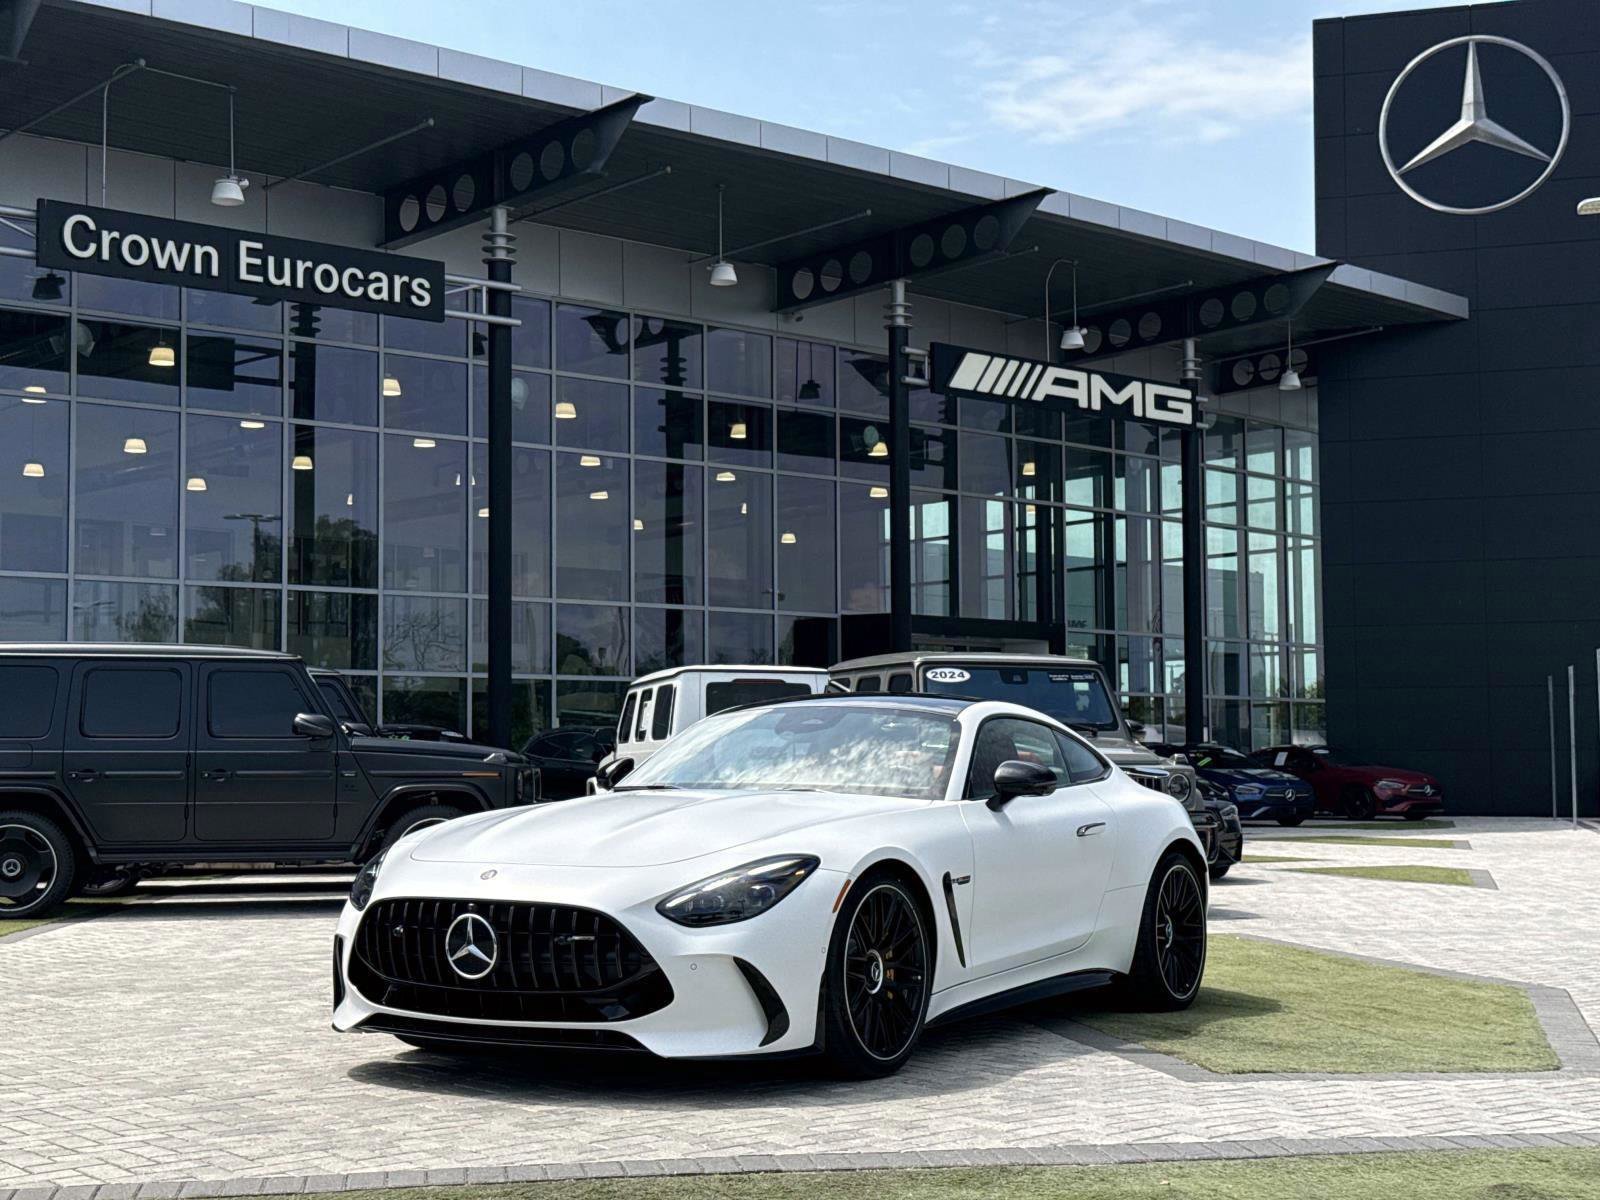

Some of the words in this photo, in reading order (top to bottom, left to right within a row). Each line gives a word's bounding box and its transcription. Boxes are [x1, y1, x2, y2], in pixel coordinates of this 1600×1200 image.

[63, 214, 219, 277] Crown
[239, 239, 432, 307] Eurocars
[1031, 366, 1193, 425] AMG
[930, 670, 966, 679] 2024
